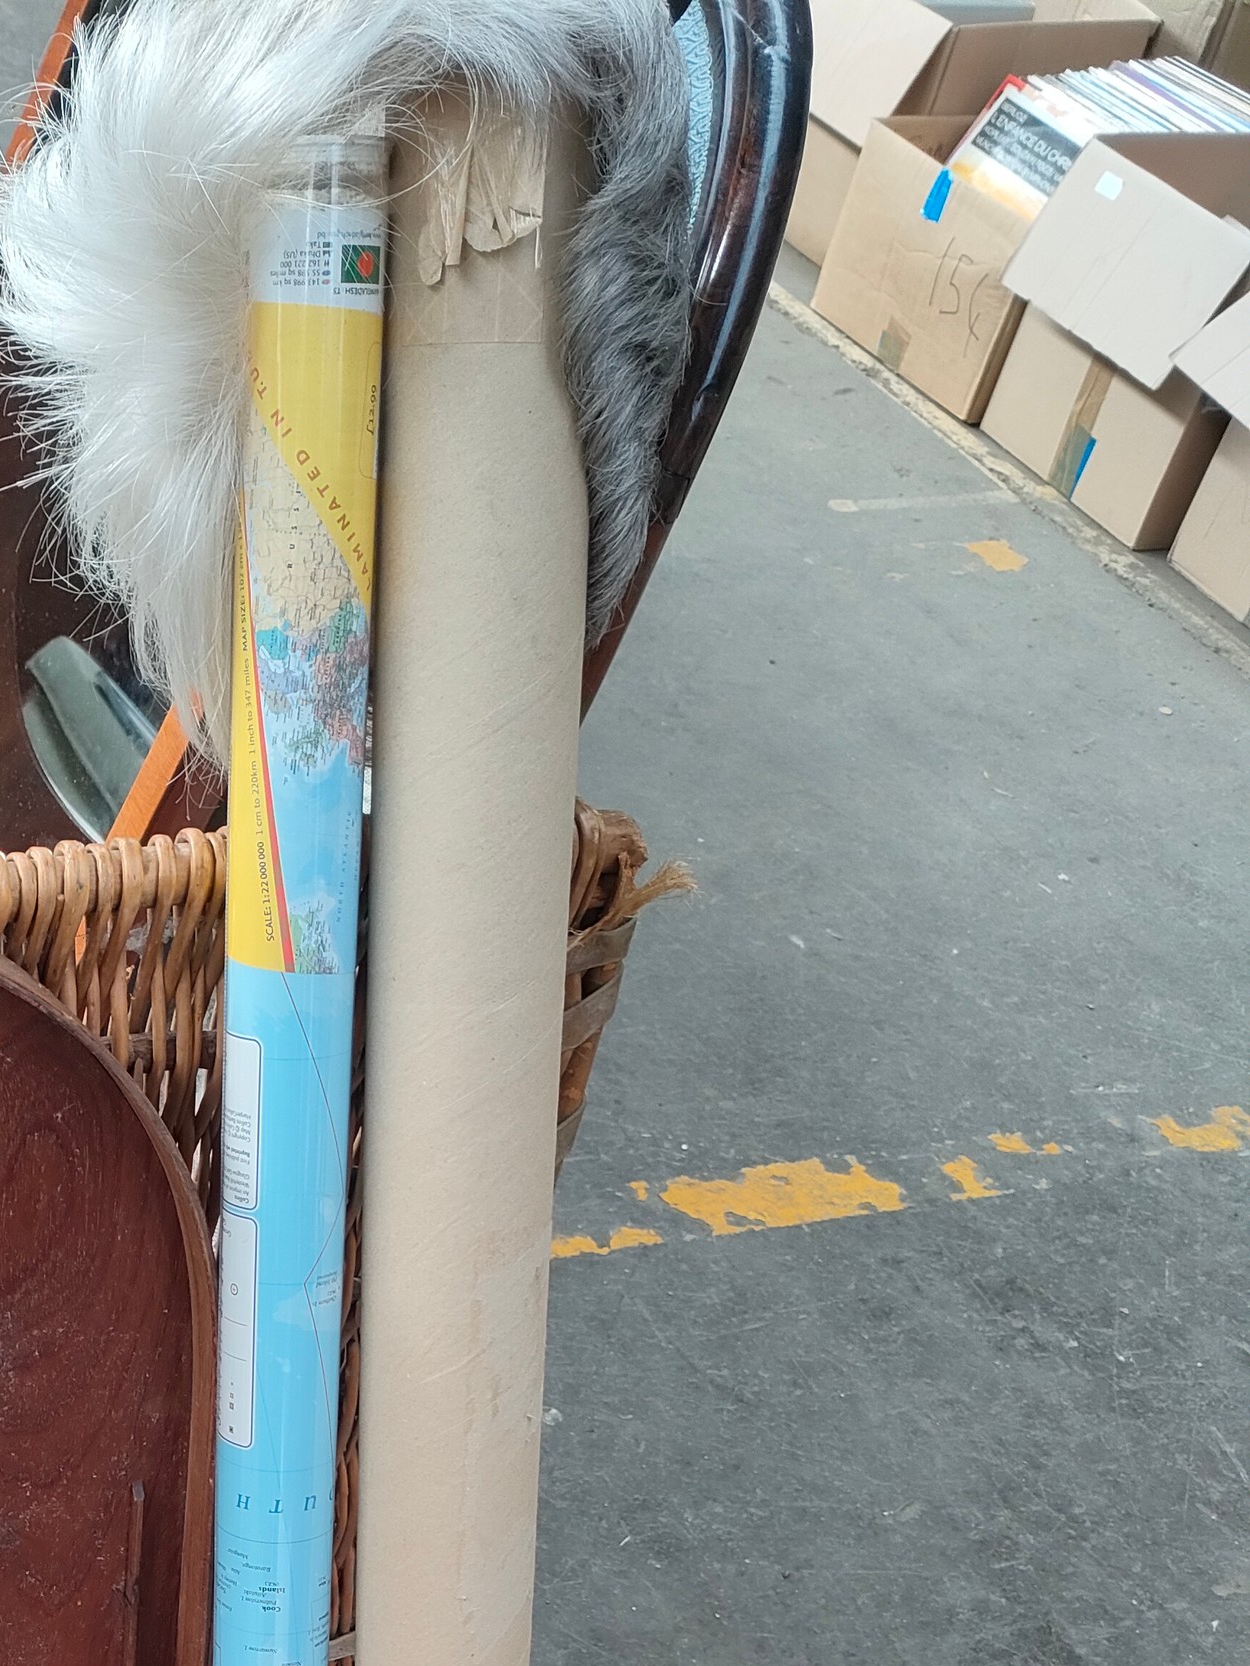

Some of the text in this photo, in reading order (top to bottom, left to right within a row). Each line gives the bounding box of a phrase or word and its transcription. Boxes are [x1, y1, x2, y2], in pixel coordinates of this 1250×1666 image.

[1034, 140, 1051, 156] DU
[270, 409, 373, 592] LAMINATED IN
[239, 594, 247, 623] SIZE:
[247, 711, 253, 721] to
[247, 724, 255, 746] inch
[249, 760, 260, 795] 220km
[253, 798, 261, 808] to
[254, 812, 263, 826] cm
[257, 841, 266, 860] 000
[258, 861, 268, 879] 000
[260, 881, 271, 904] 1:22
[264, 906, 275, 941] SCALE:
[236, 1487, 334, 1514] UTH
